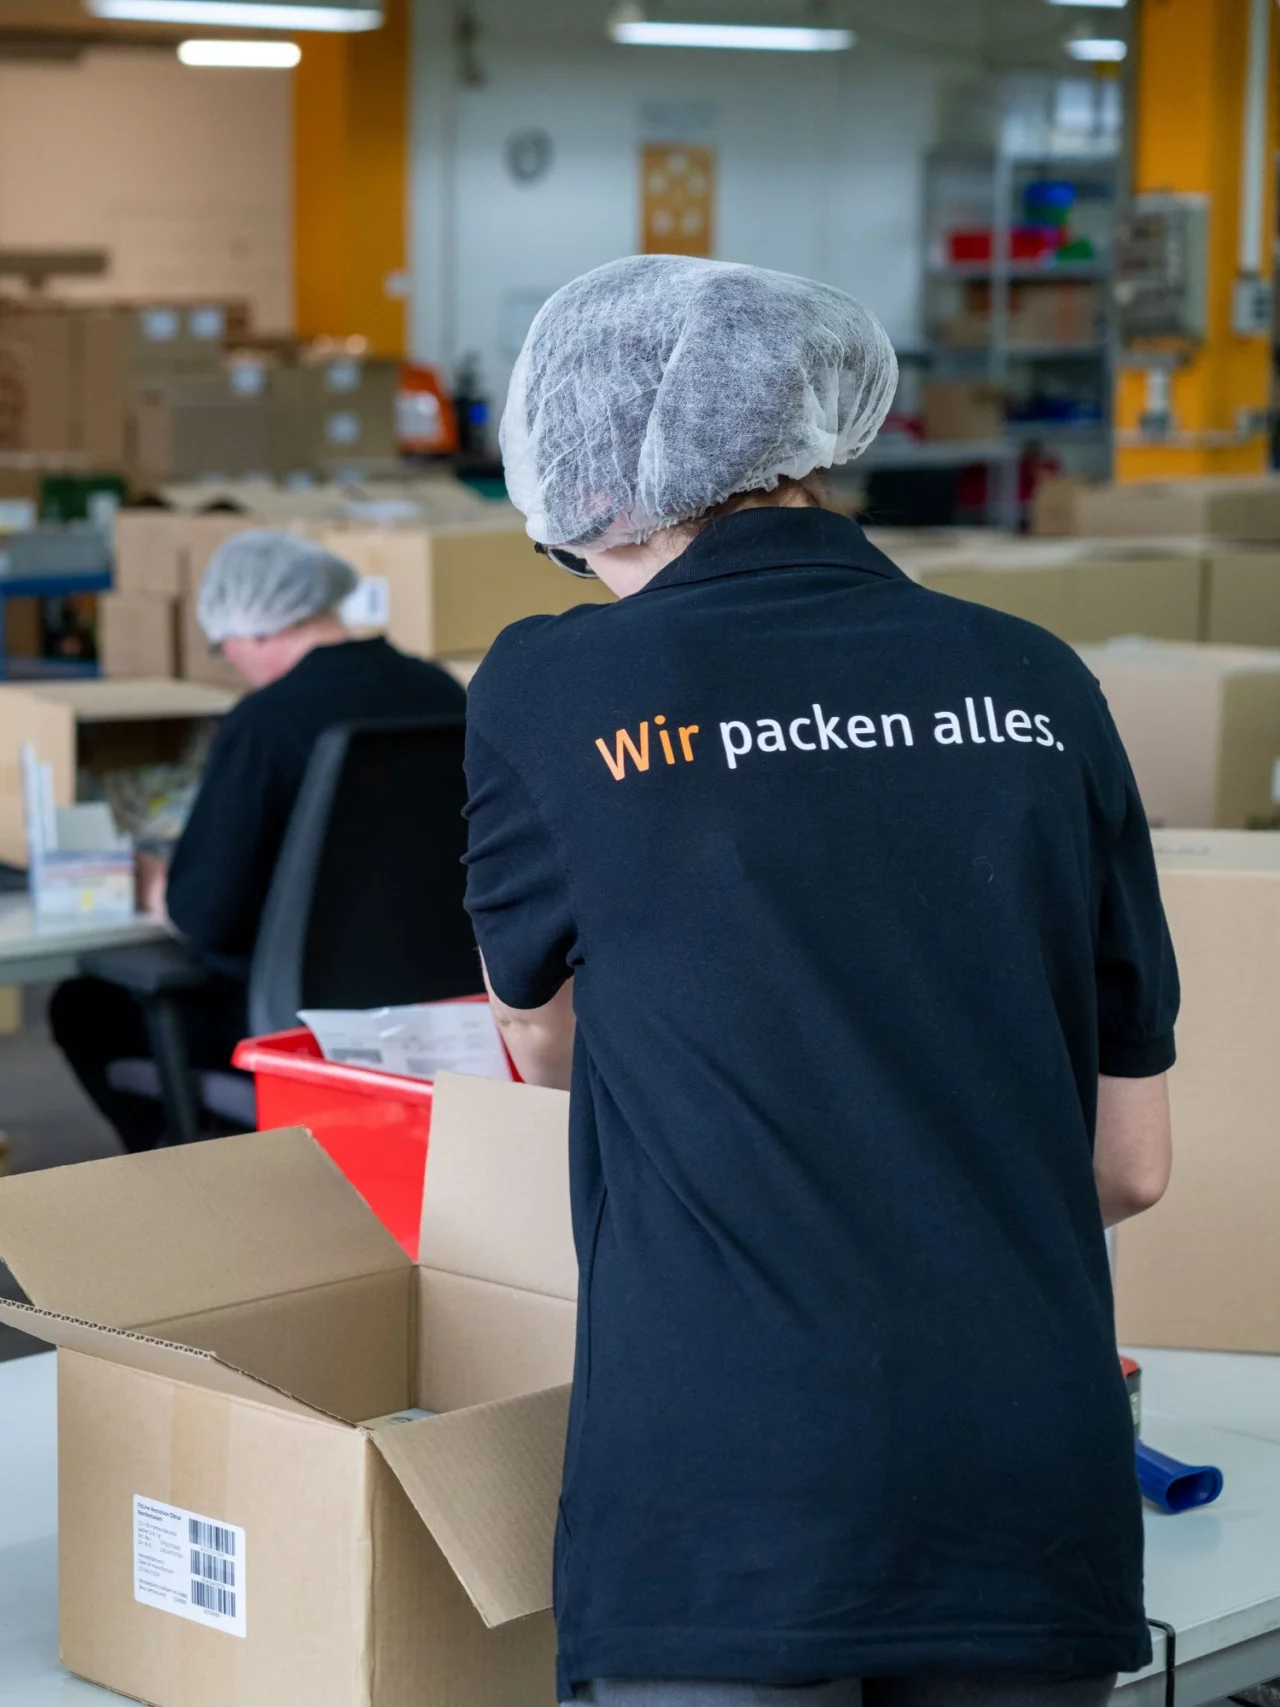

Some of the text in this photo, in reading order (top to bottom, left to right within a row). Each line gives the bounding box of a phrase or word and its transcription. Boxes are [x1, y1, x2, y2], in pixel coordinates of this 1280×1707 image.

[595, 696, 1065, 781] Wir packen alles.
